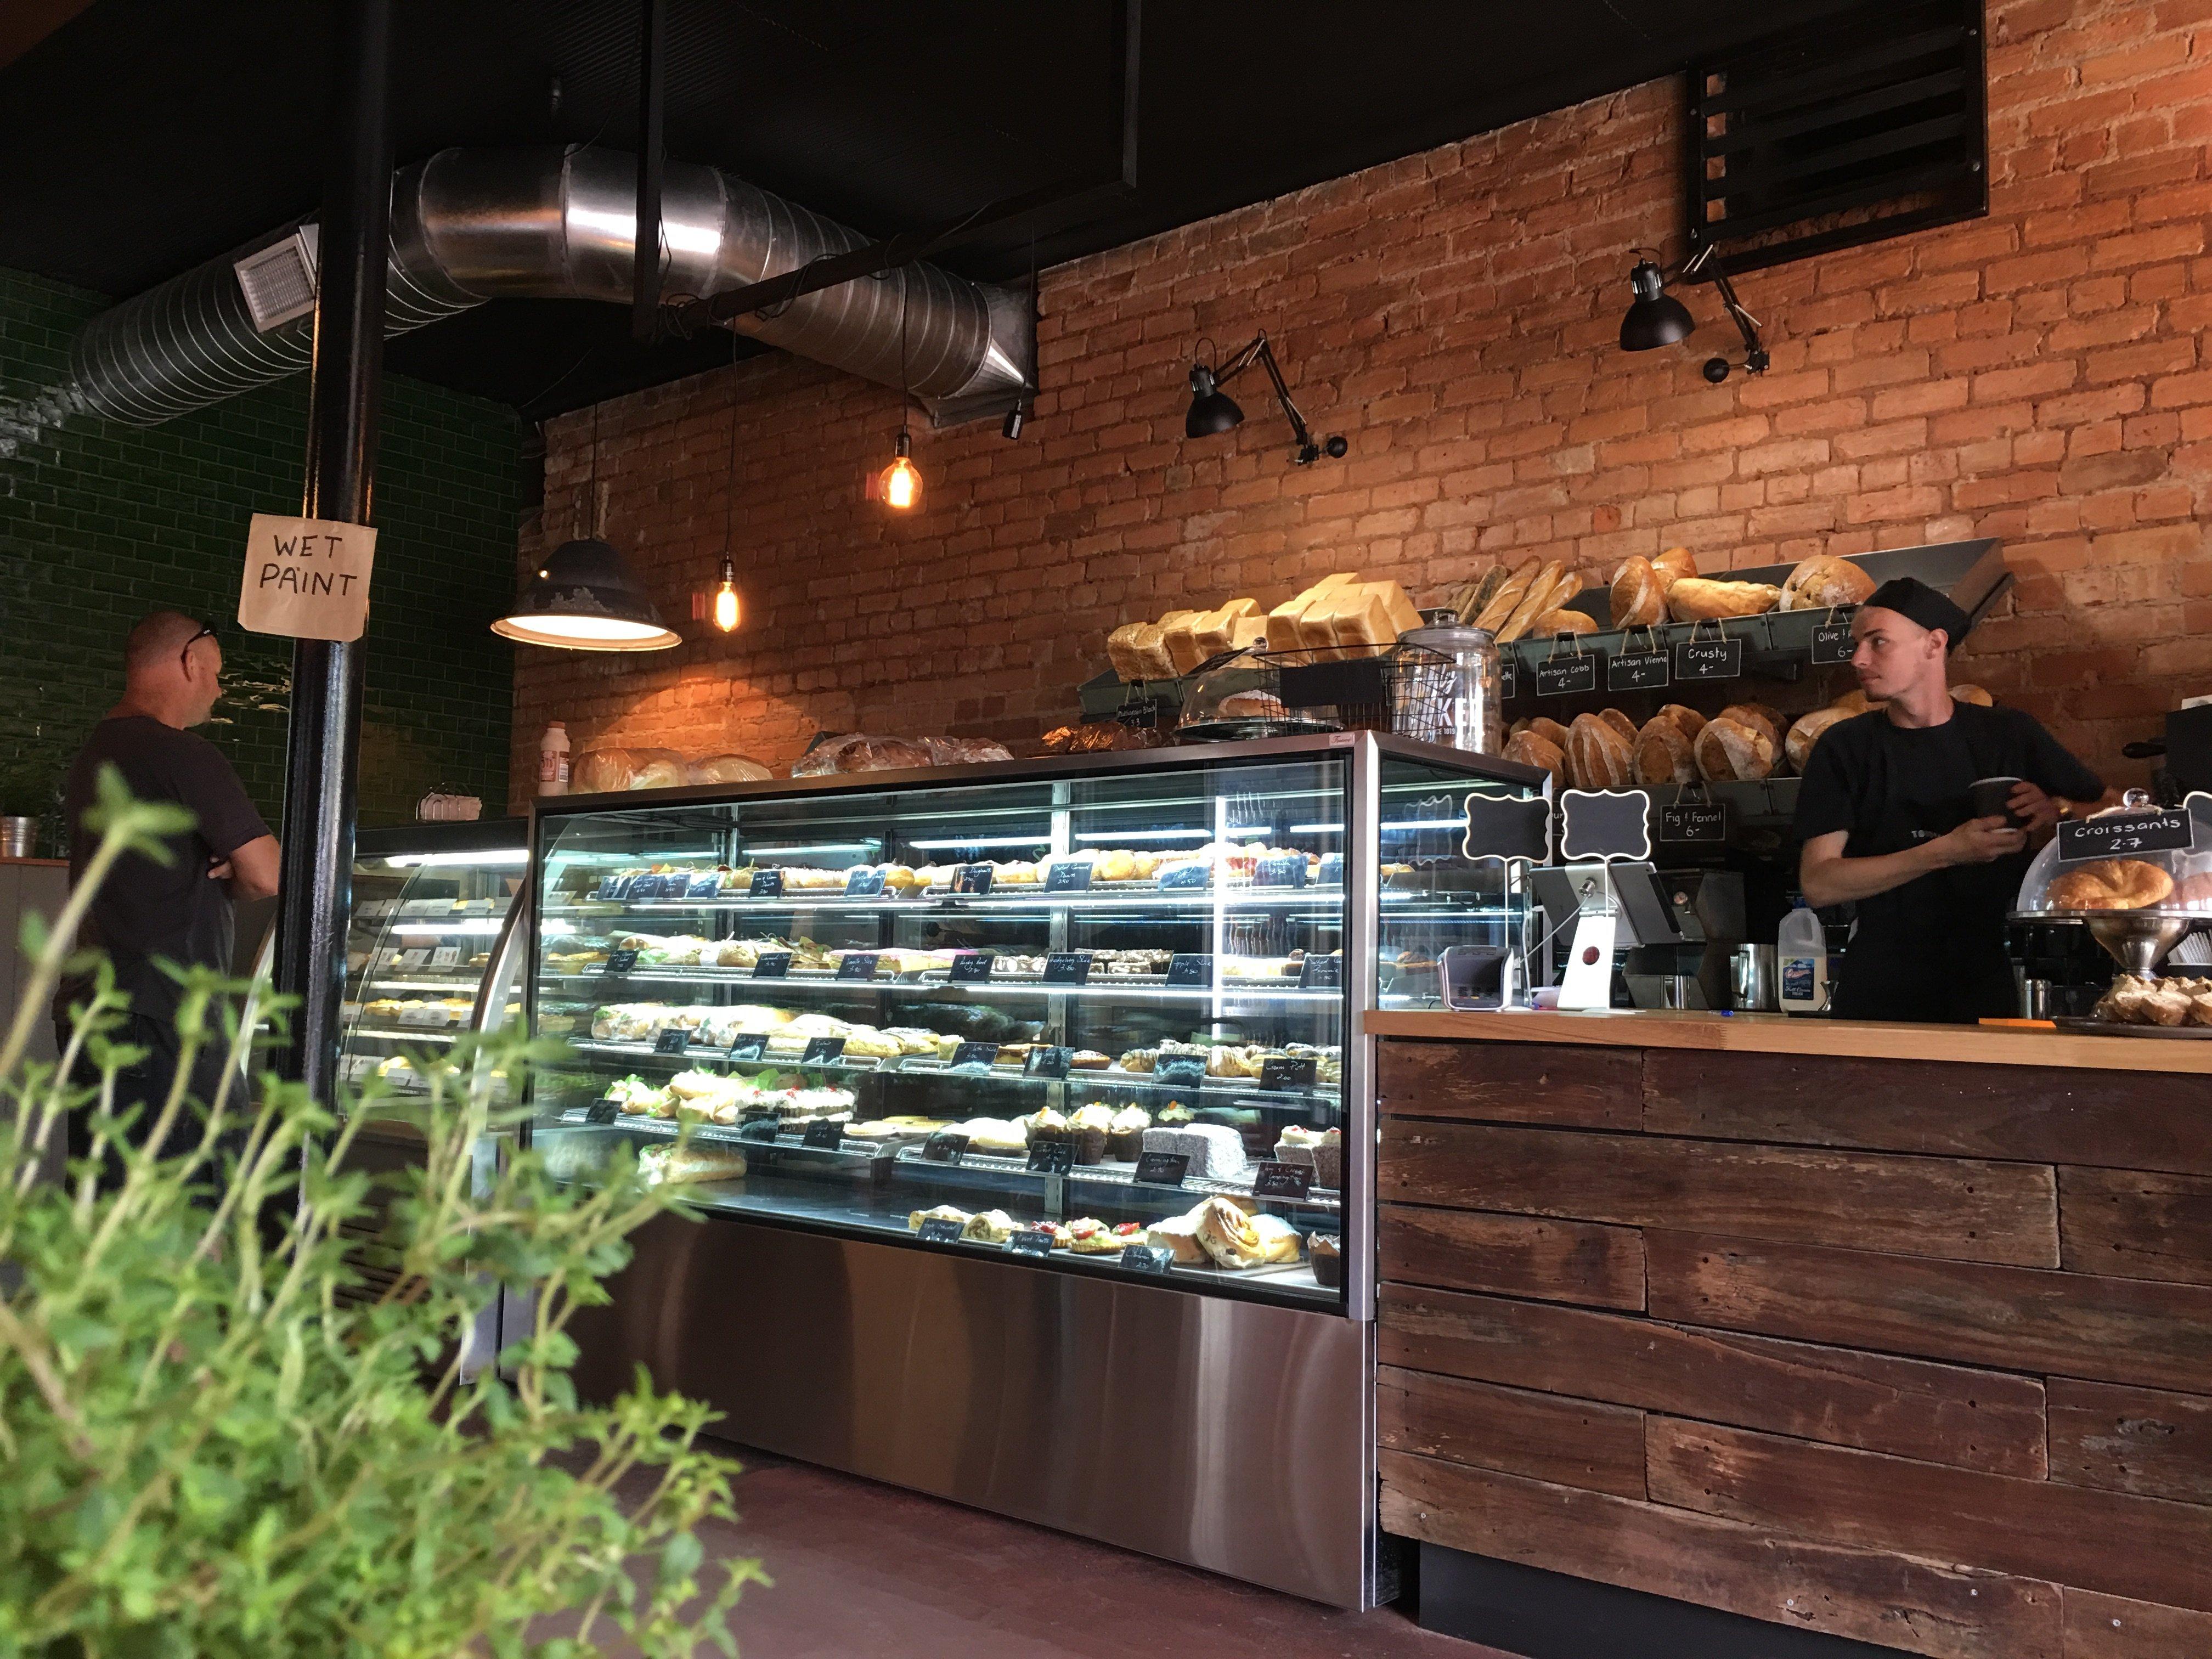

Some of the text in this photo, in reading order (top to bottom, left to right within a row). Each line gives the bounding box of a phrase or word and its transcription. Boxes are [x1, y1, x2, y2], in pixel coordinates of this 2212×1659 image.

[274, 534, 342, 558] WET
[259, 563, 357, 596] PAINT
[1818, 631, 1839, 642] Olive
[1688, 647, 1727, 662] Crusty
[1611, 656, 1667, 669] Artisan Vienna
[1539, 664, 1590, 678] Artisan Cobb
[1666, 812, 1680, 826] Fig
[2075, 817, 2181, 838] Croissants
